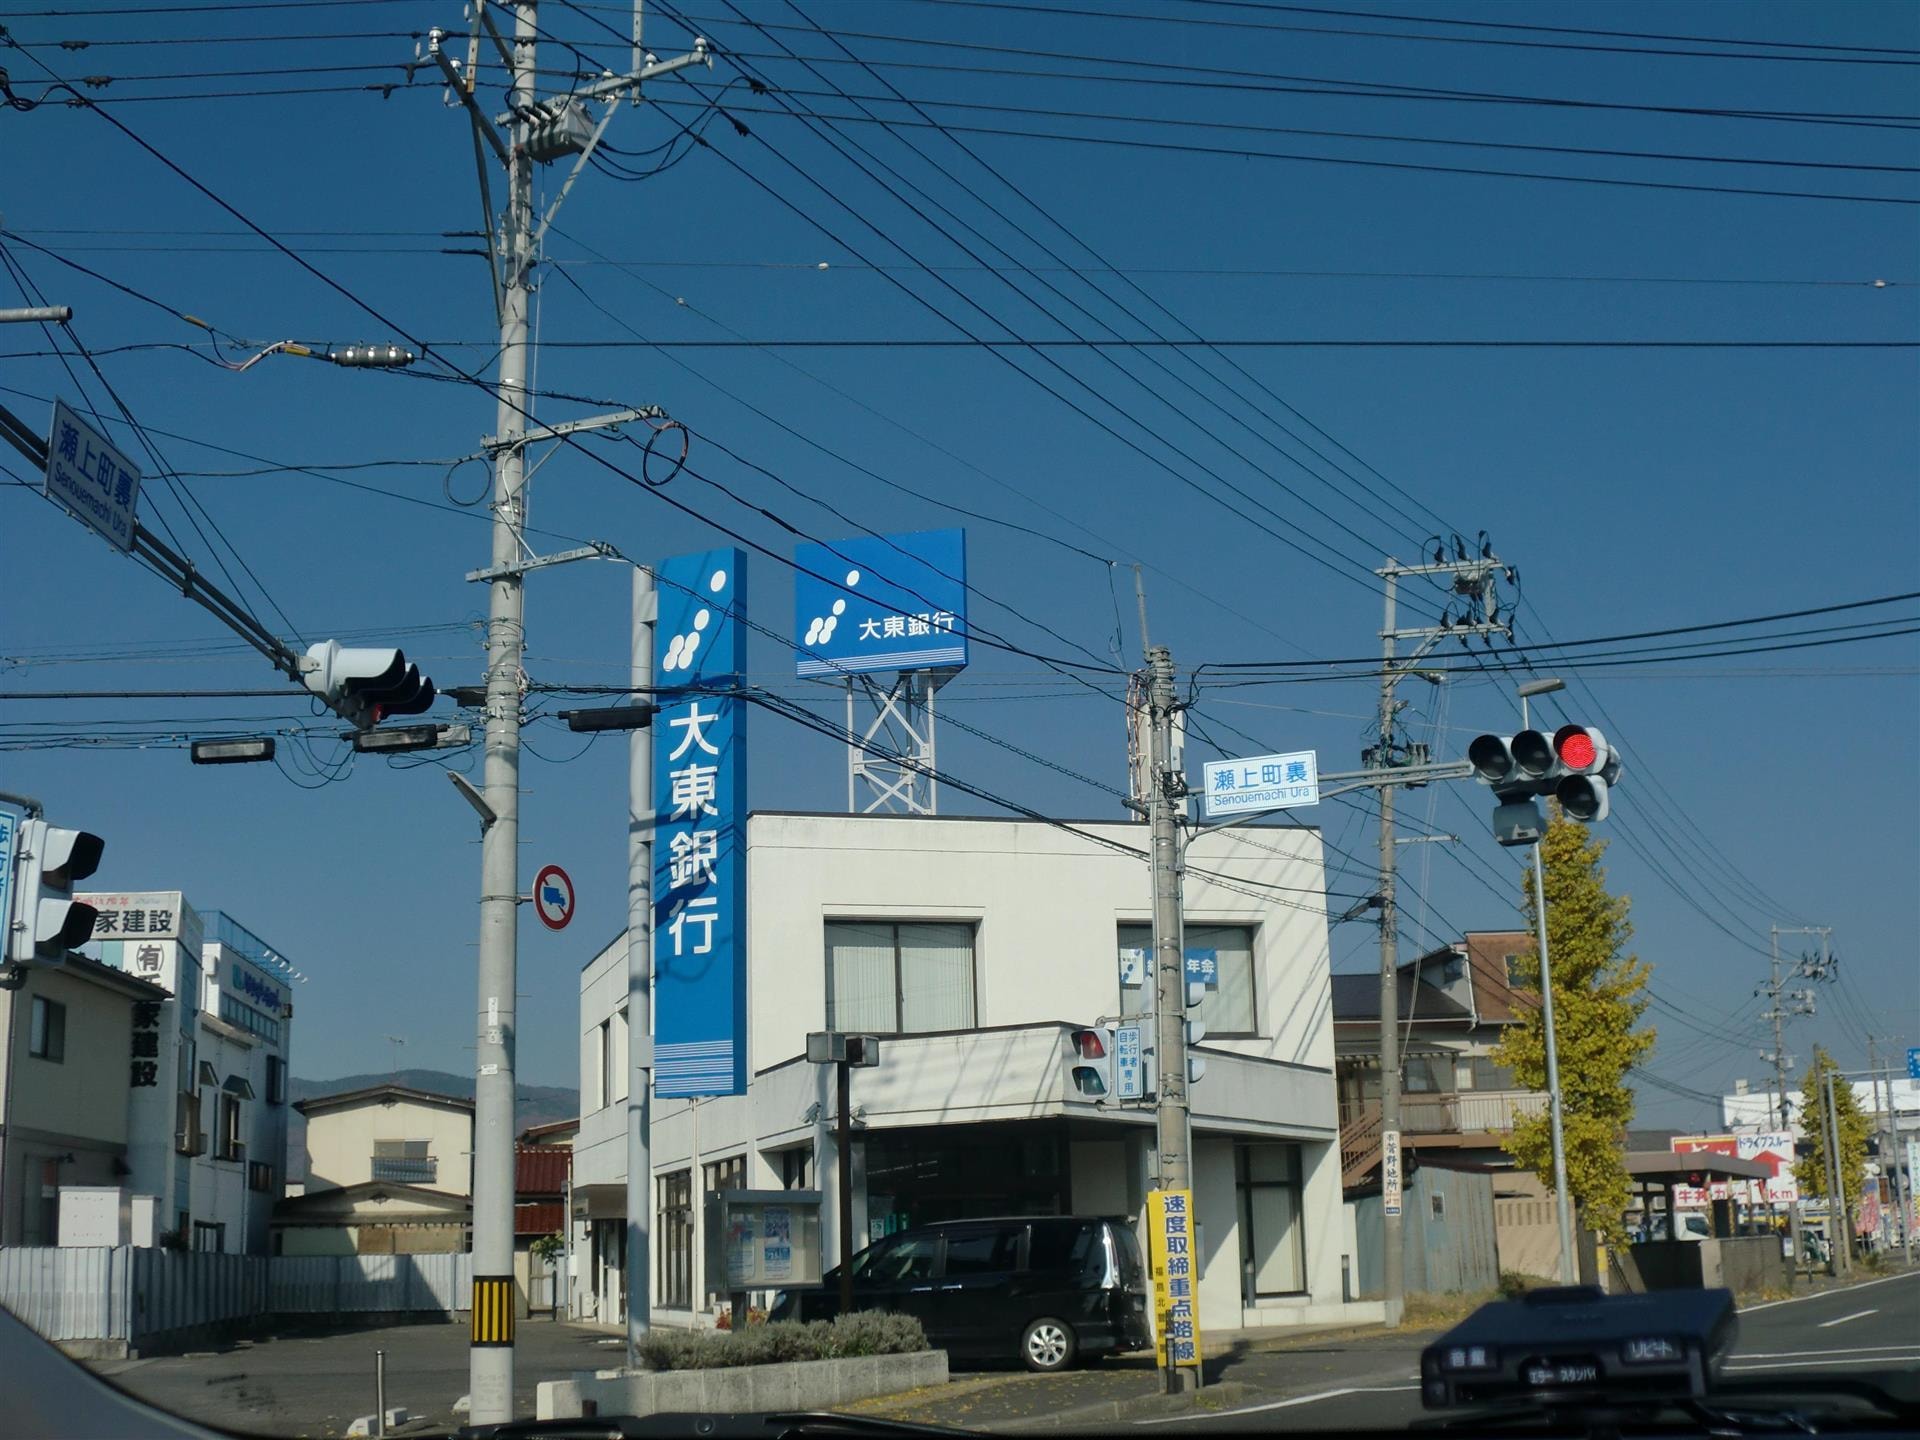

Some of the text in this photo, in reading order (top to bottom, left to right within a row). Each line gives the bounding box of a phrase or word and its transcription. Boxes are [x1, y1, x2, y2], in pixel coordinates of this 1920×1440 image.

[58, 419, 134, 513] 瀬上町裏
[55, 462, 127, 537] Senouemachi Ura
[859, 610, 955, 641] 大東銀行
[1214, 760, 1308, 791] 瀬上町裏
[1215, 787, 1309, 806] Senouemachi Ura
[668, 702, 720, 957] 大東銀行
[95, 909, 173, 934] 家建設
[1187, 959, 1215, 974] 年金
[1164, 1195, 1196, 1360] 速度取締重点路線
[1631, 1339, 1673, 1359] リピート
